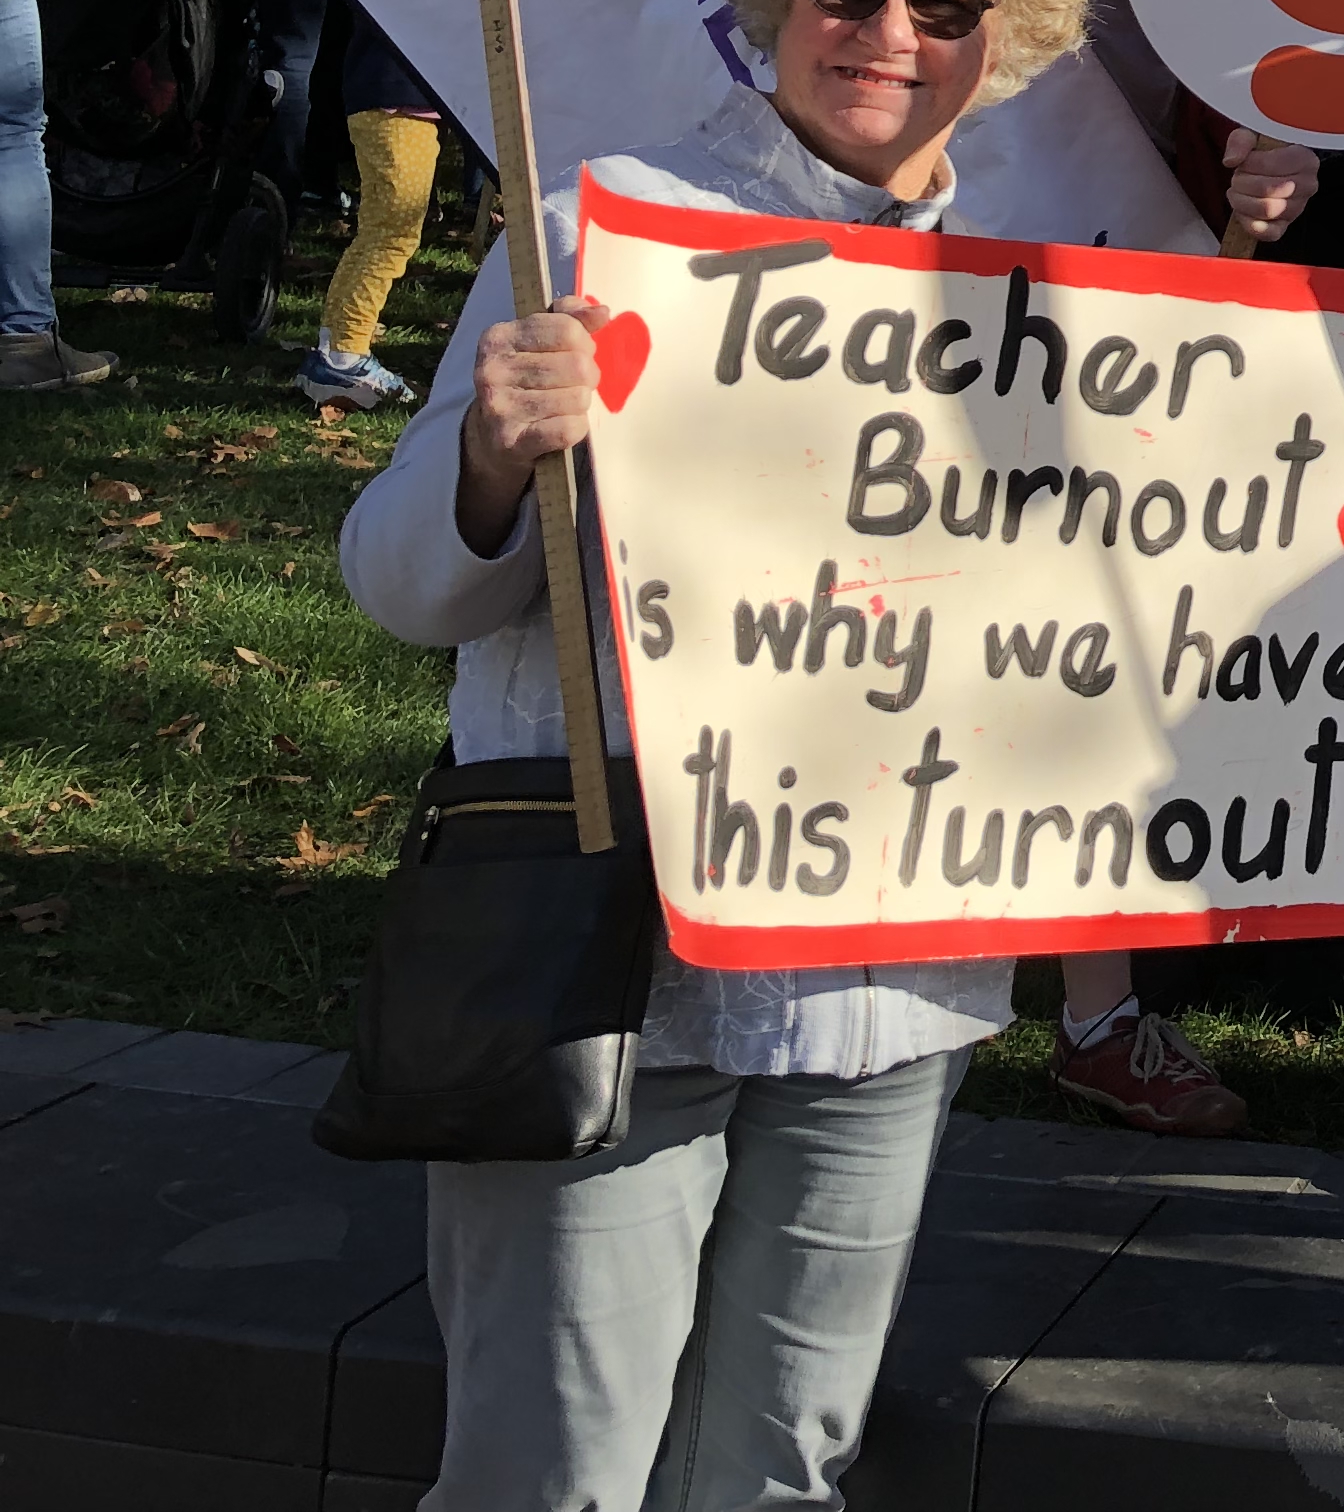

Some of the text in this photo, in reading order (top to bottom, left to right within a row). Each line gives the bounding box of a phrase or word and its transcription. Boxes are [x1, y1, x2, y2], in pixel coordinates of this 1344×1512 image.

[688, 238, 1246, 420] Teacher
[846, 412, 1324, 557] Burnout
[619, 540, 675, 661] is
[734, 558, 935, 712] why
[984, 619, 1117, 697] we
[683, 724, 852, 896] this
